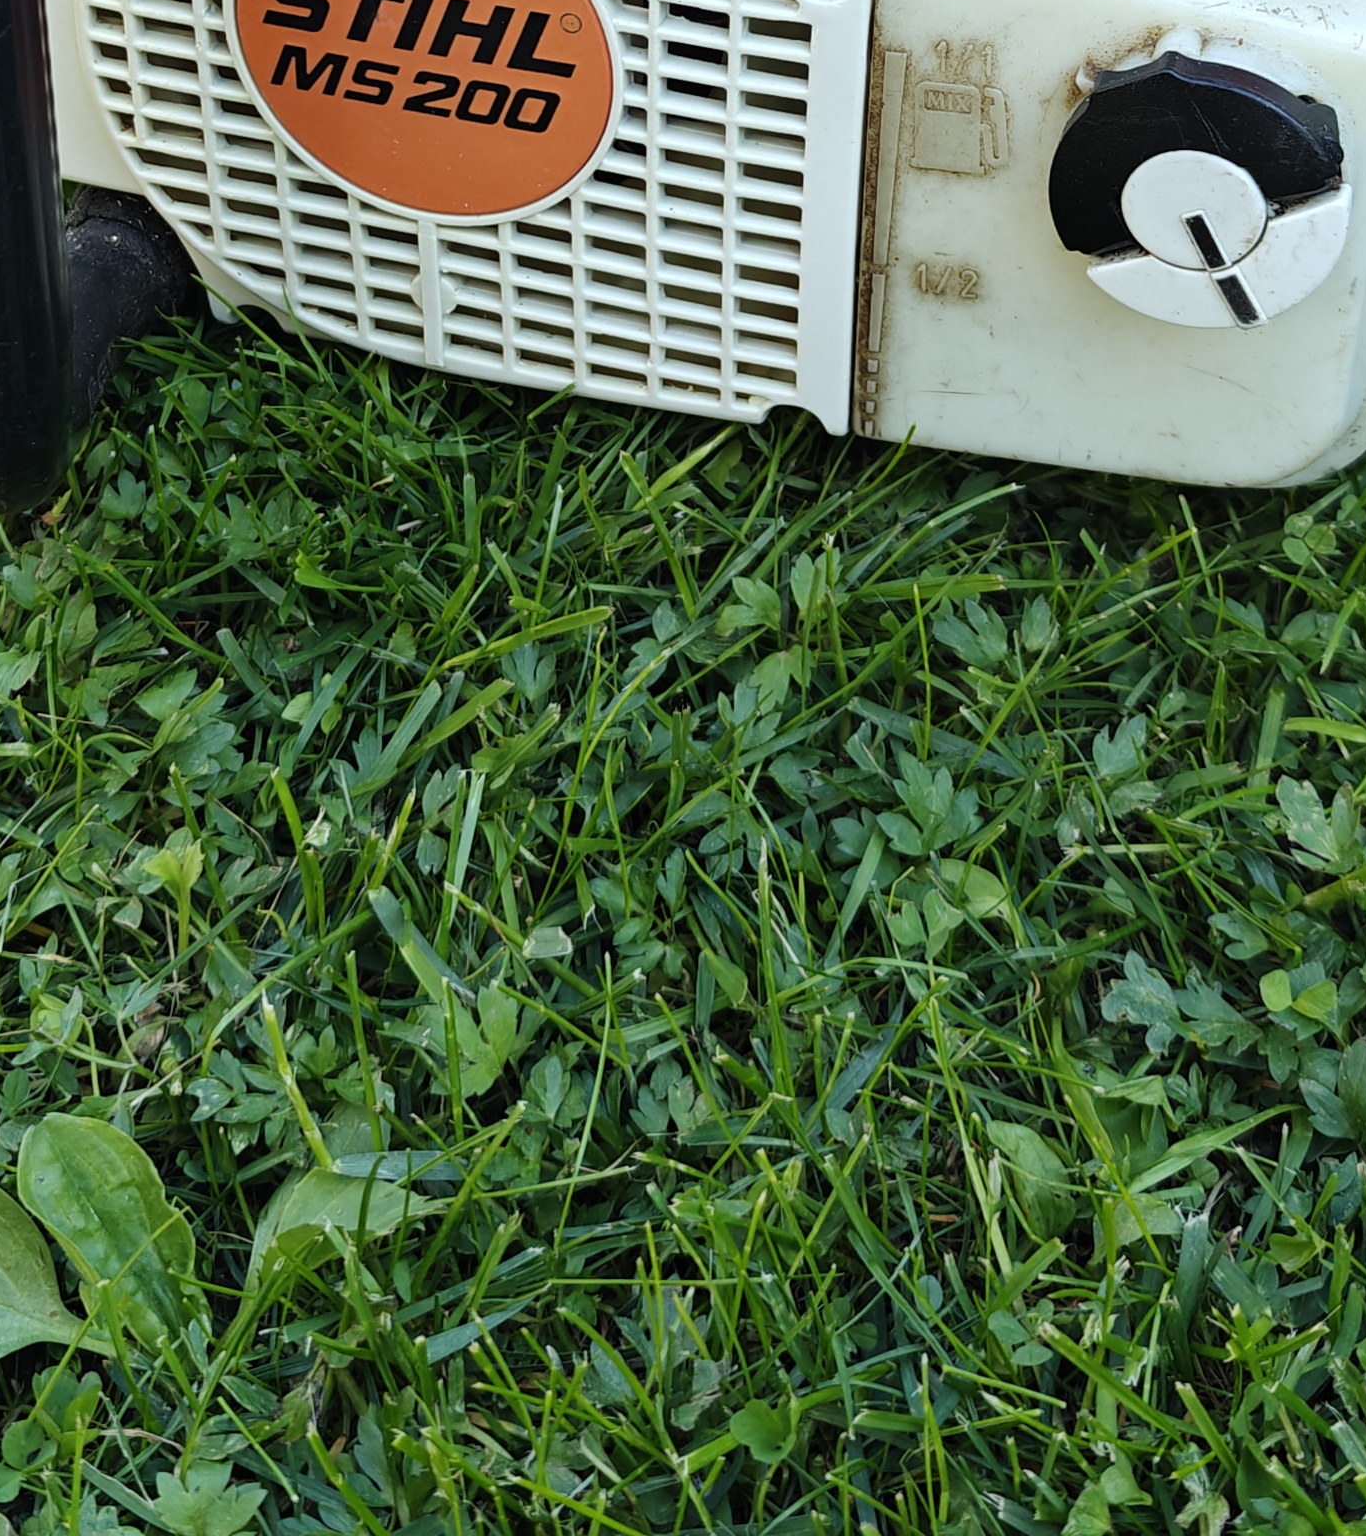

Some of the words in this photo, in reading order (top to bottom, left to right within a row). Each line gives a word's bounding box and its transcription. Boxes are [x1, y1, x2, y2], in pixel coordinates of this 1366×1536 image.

[270, 44, 401, 107] MS
[402, 70, 561, 134] 200
[924, 89, 973, 114] MIX
[915, 262, 979, 298] 1/2
